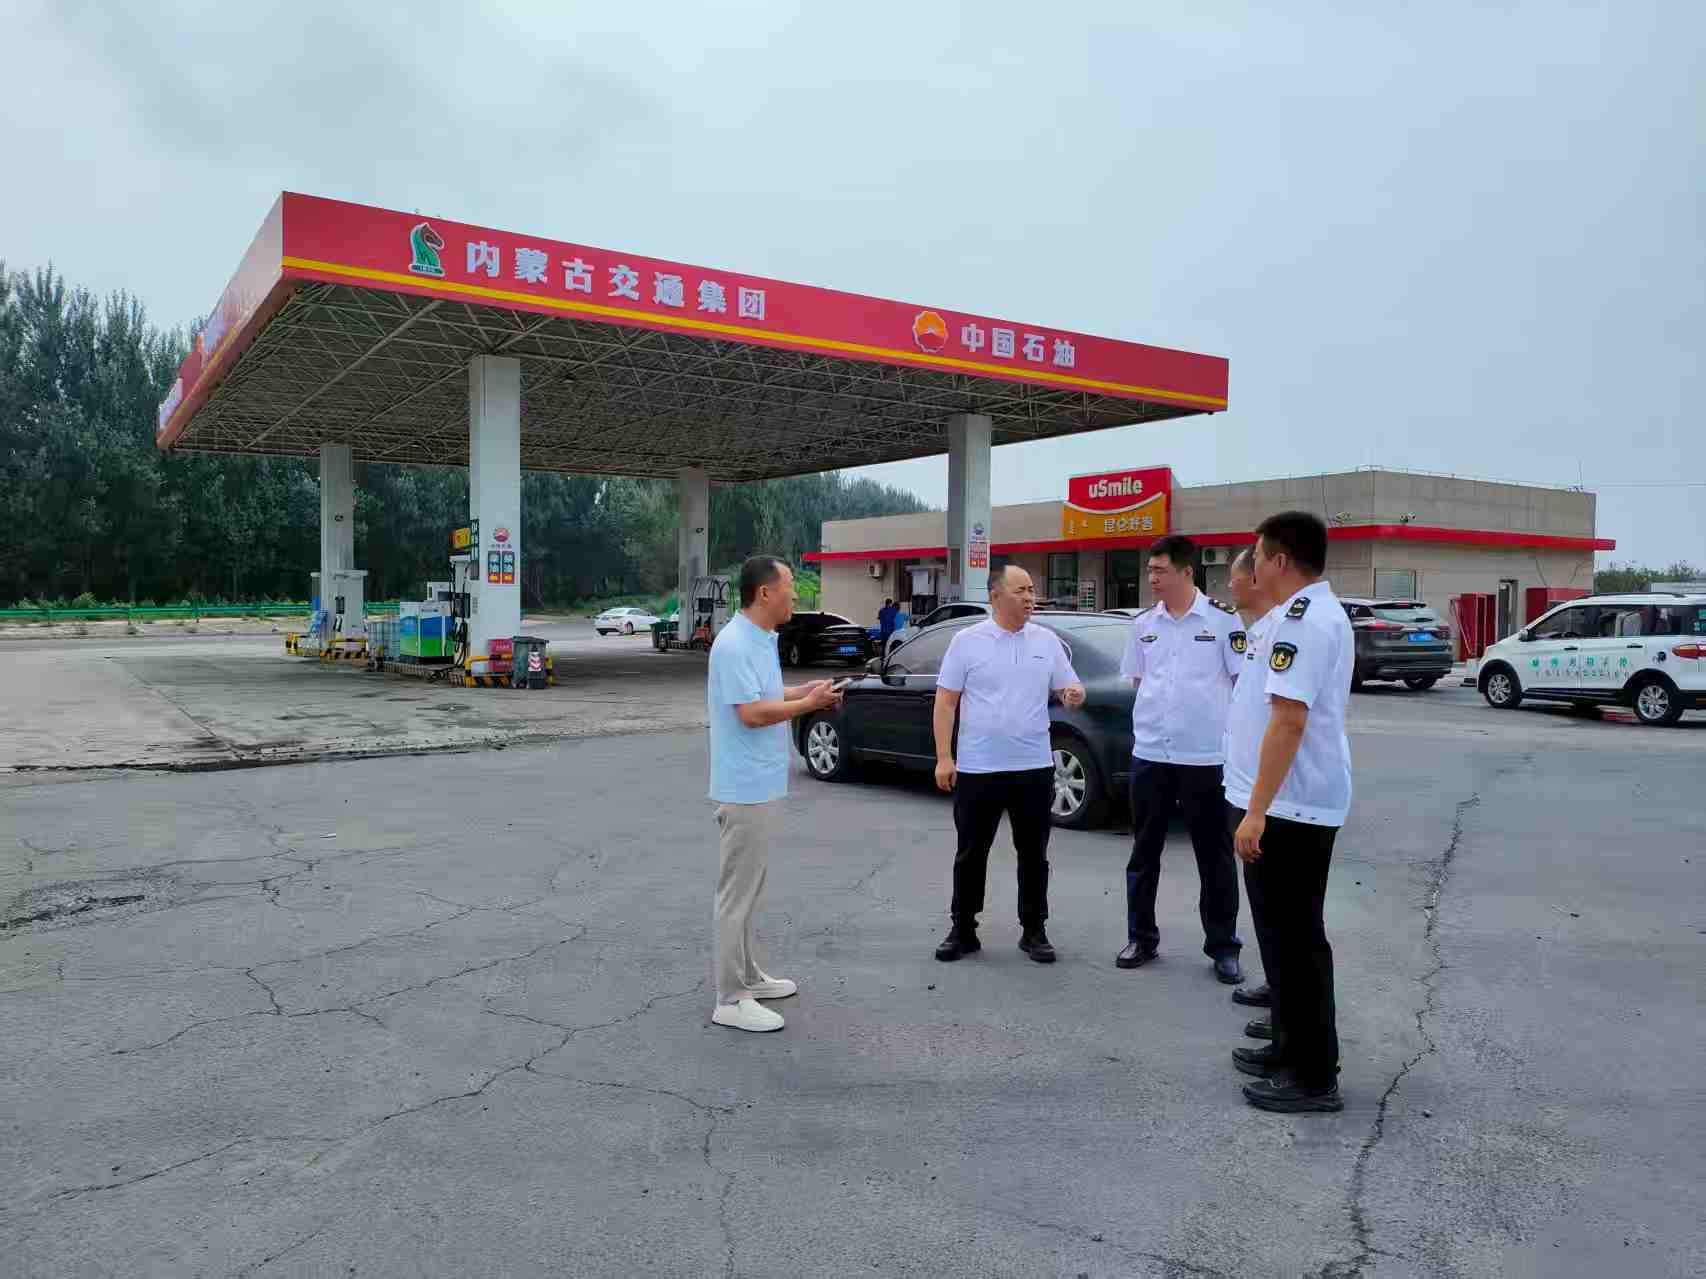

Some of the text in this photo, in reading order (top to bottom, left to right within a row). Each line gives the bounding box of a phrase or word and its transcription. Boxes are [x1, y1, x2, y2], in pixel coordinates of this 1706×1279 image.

[466, 240, 766, 321] 内蒙古交通集团
[961, 323, 1076, 369] 中国石油
[1088, 476, 1143, 498] uSmile
